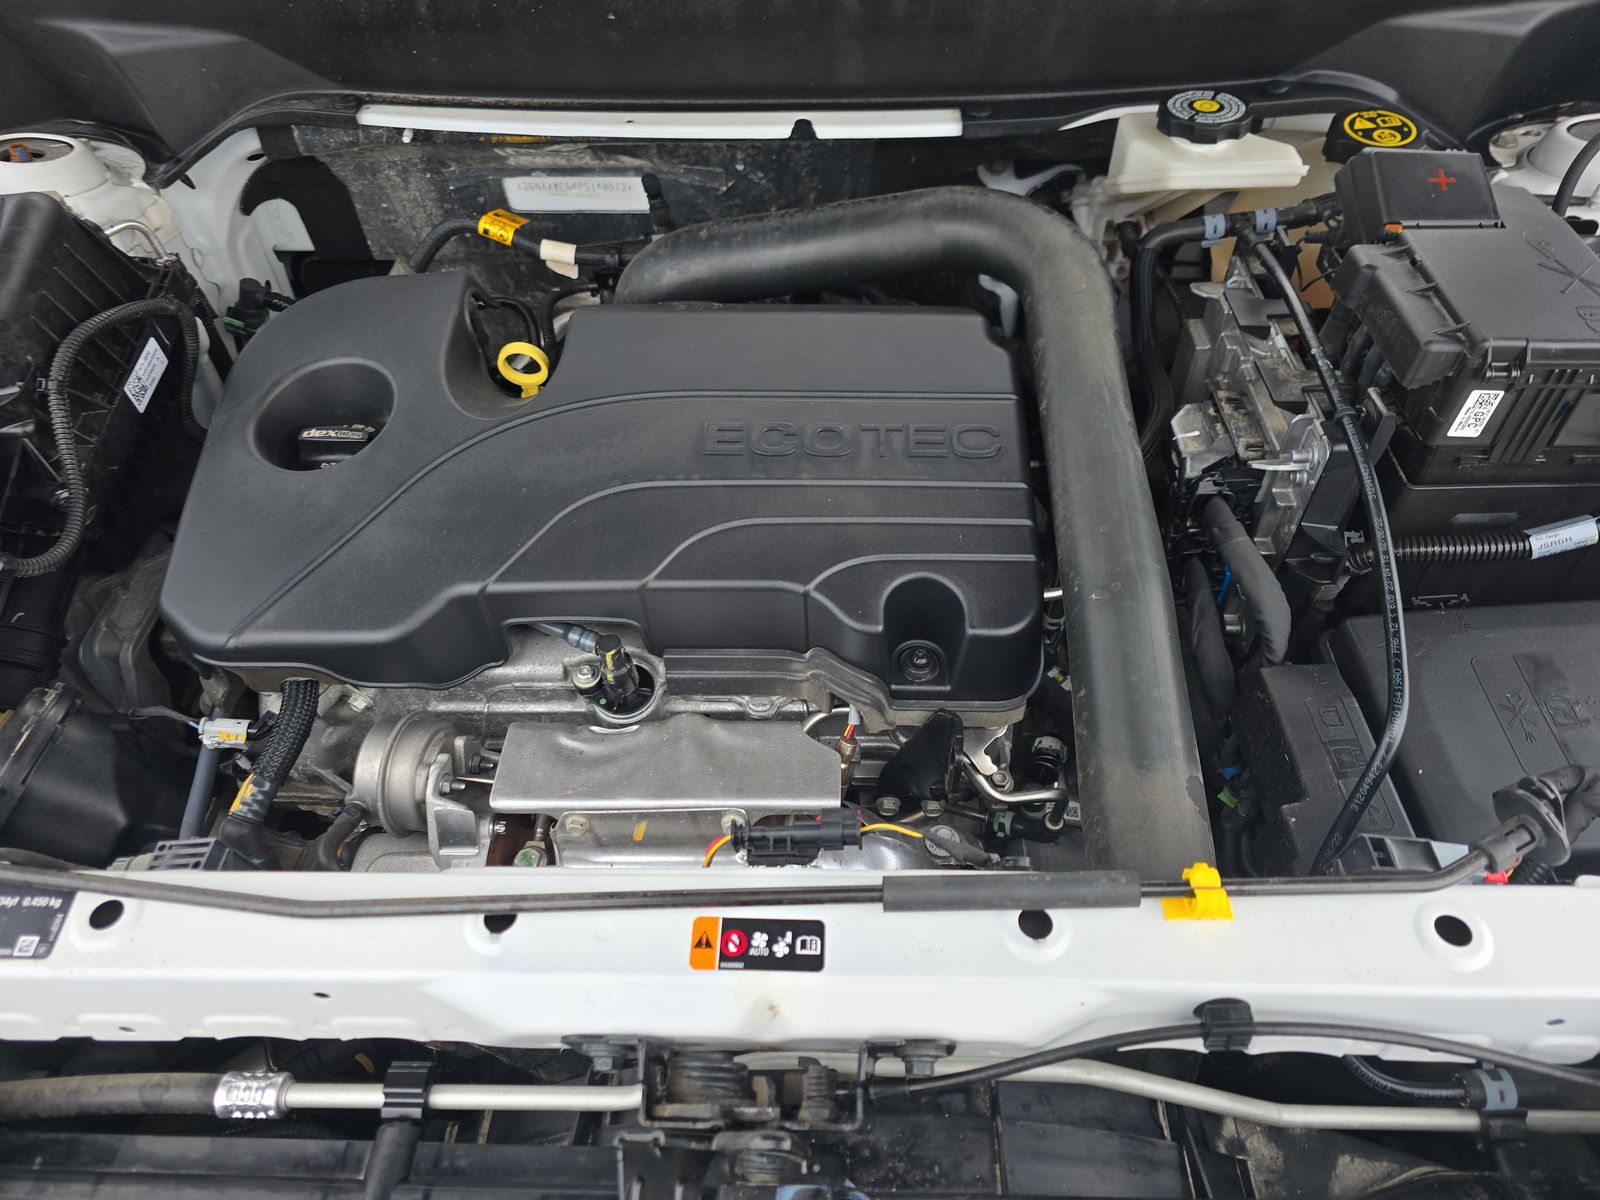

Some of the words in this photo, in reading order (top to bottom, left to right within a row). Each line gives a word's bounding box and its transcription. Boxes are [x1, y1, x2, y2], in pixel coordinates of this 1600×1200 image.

[1467, 411, 1485, 429] GPC
[301, 428, 364, 440] dexos
[701, 420, 1002, 459] ECOTEC
[1350, 761, 1384, 813] 312049423
[49, 897, 64, 910] kg
[748, 946, 770, 957] AUTO
